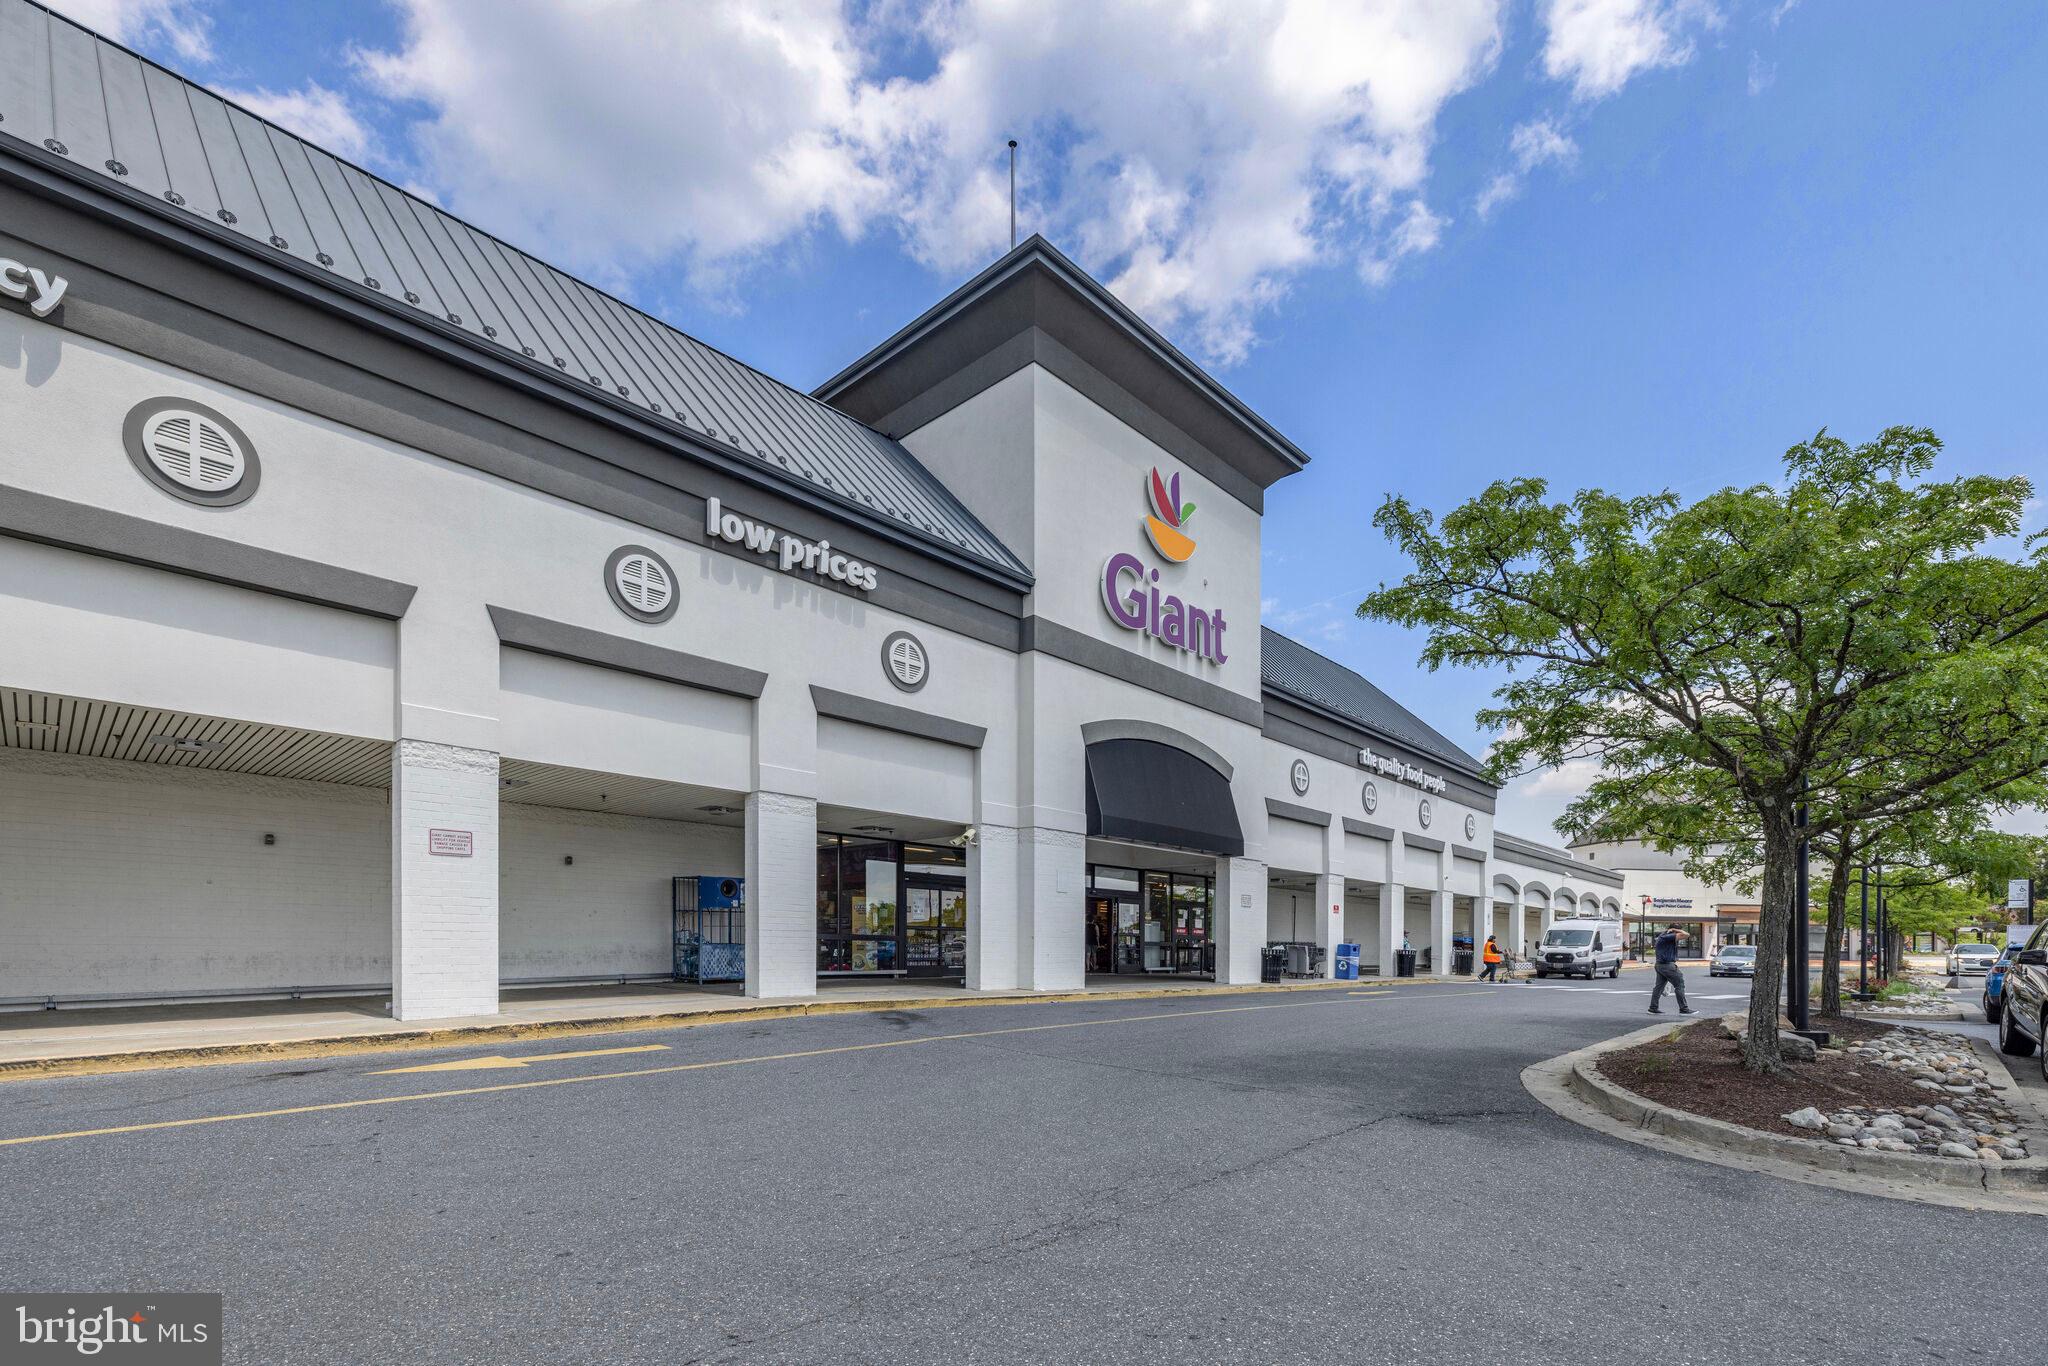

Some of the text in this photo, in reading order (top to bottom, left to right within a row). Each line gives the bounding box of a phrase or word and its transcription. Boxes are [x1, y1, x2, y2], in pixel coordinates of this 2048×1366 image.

[706, 496, 878, 591] low prices
[1101, 552, 1229, 666] Giant
[1359, 747, 1446, 794] the quality food people
